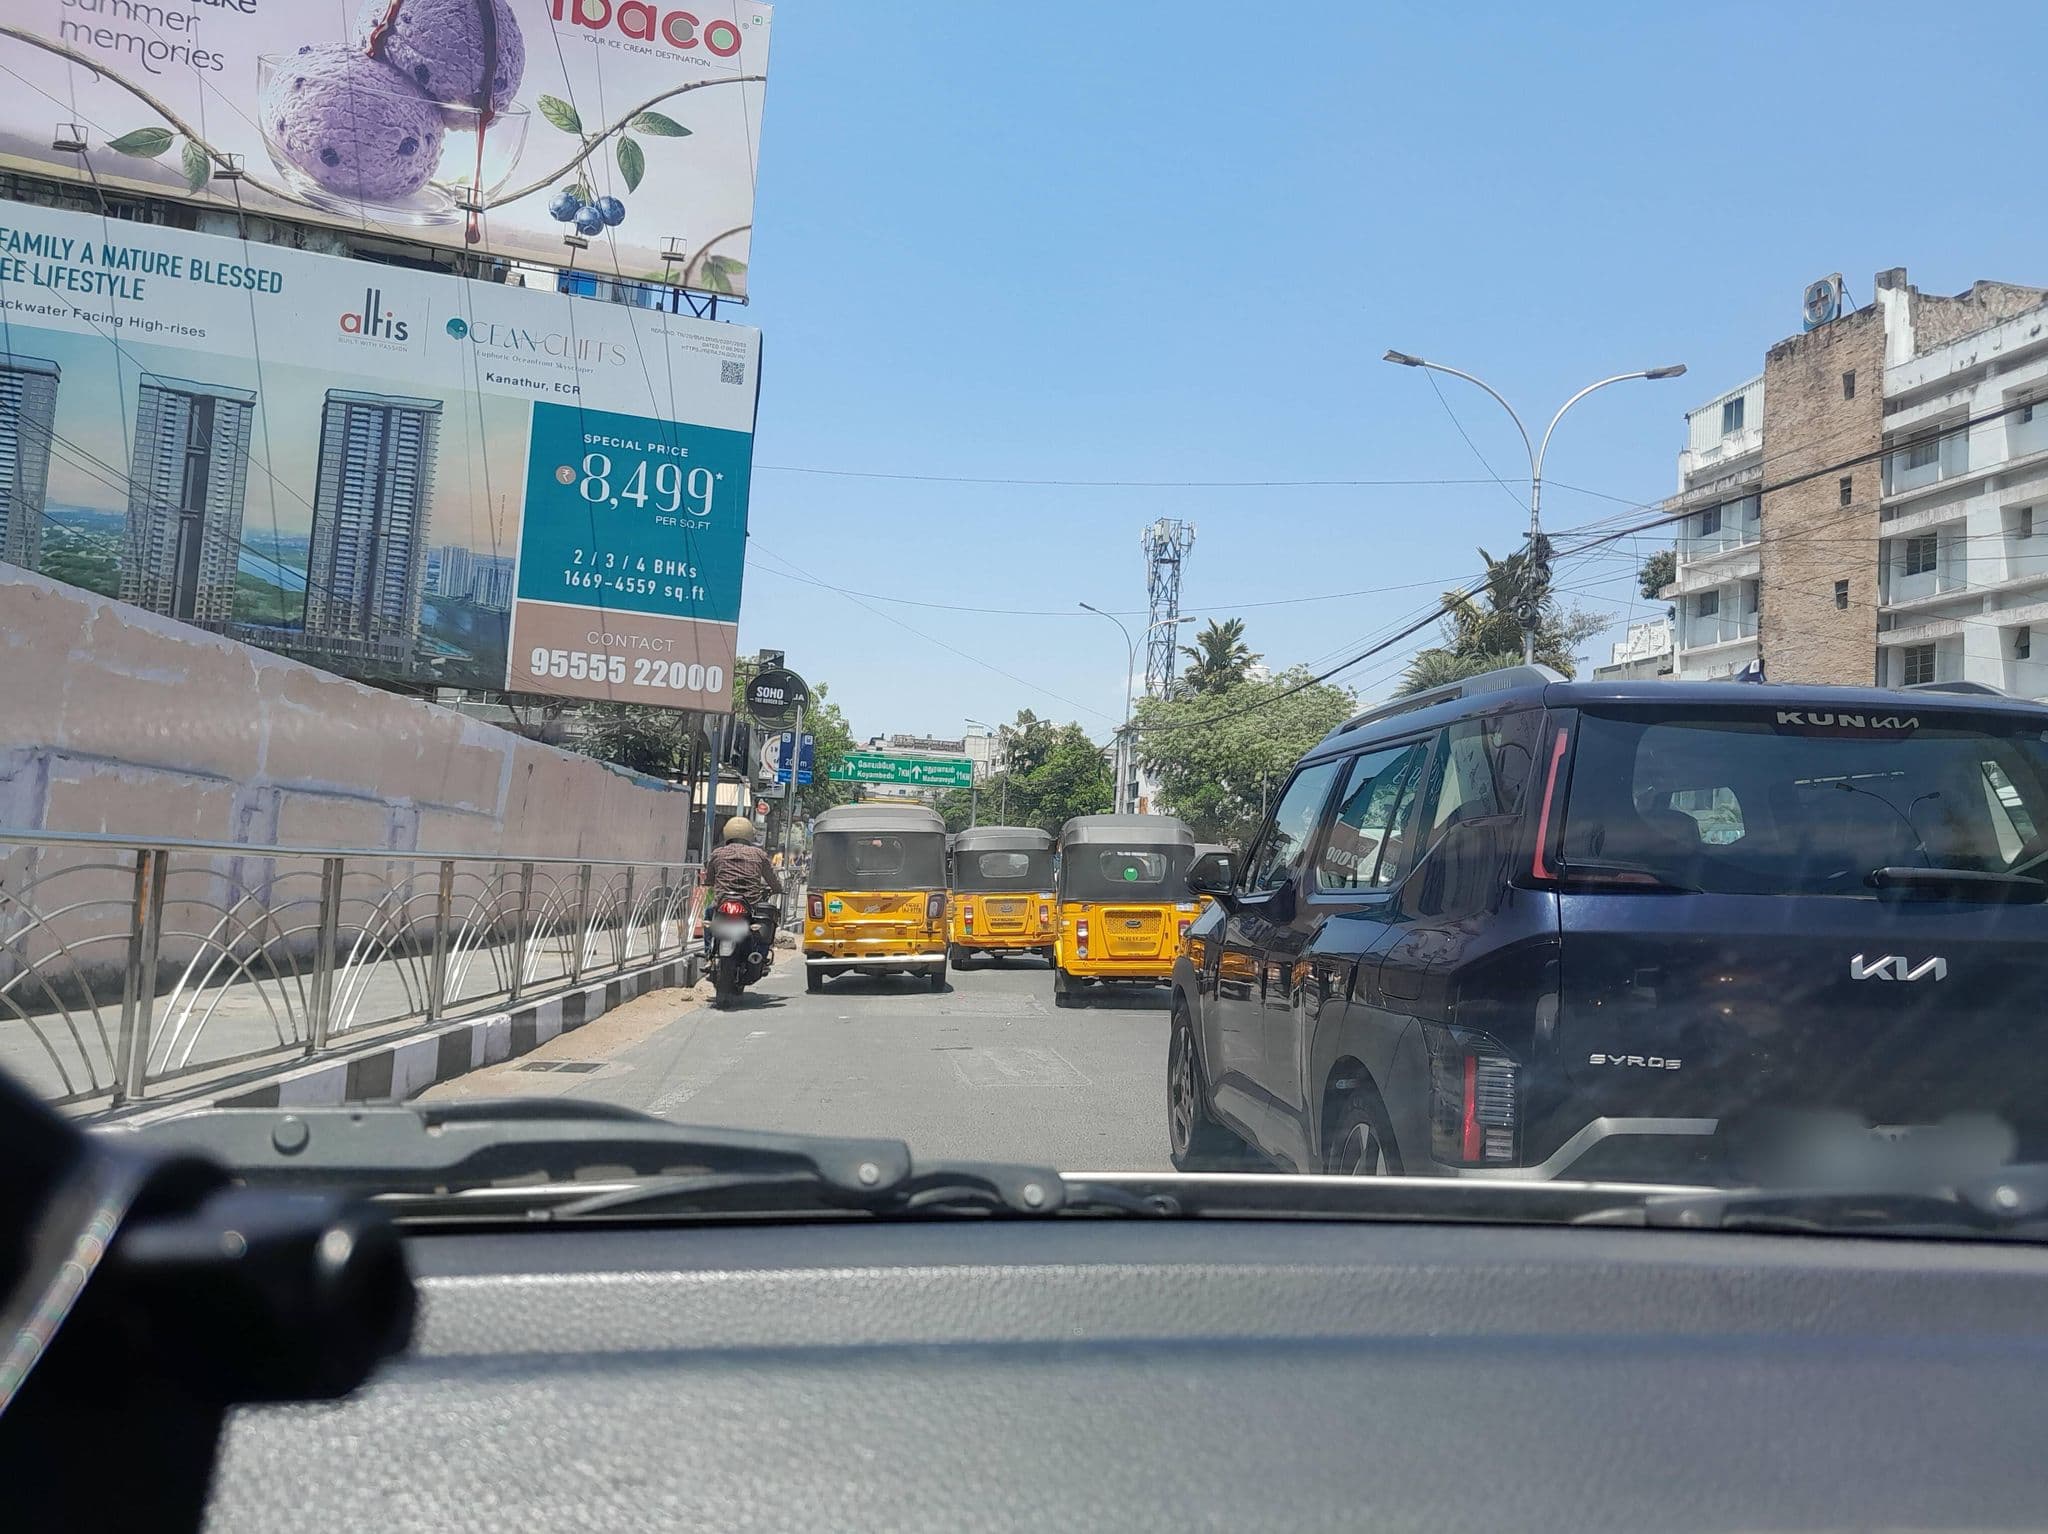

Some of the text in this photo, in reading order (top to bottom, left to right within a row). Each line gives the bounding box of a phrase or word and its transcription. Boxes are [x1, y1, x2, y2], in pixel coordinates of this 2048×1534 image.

[60, 20, 224, 74] memories
[583, 33, 711, 68] YOUR ICE CREAM DESTINATION
[33, 262, 146, 301] LIFESTYLE
[80, 241, 94, 265] A
[101, 244, 183, 278] NATURE
[189, 258, 283, 293] BLESSED
[73, 307, 123, 328] Facing
[129, 316, 207, 338] High-rises
[486, 372, 581, 395] Kanathur, ECR
[583, 433, 689, 458] SPECIAL PRICE
[655, 515, 711, 531] PER SQ.FT
[573, 549, 583, 565] 2
[605, 553, 615, 568] 3
[636, 557, 646, 572] 4
[654, 558, 697, 578] BHKs
[564, 570, 705, 603] 1669-4559 sq.ft
[586, 631, 675, 652] CONTACT
[530, 647, 724, 694] 95555 22000
[756, 686, 784, 699] SOHO
[1776, 711, 1921, 729] KUN KIA
[1851, 953, 1948, 982] KIA
[1589, 1053, 1682, 1070] SYROS
